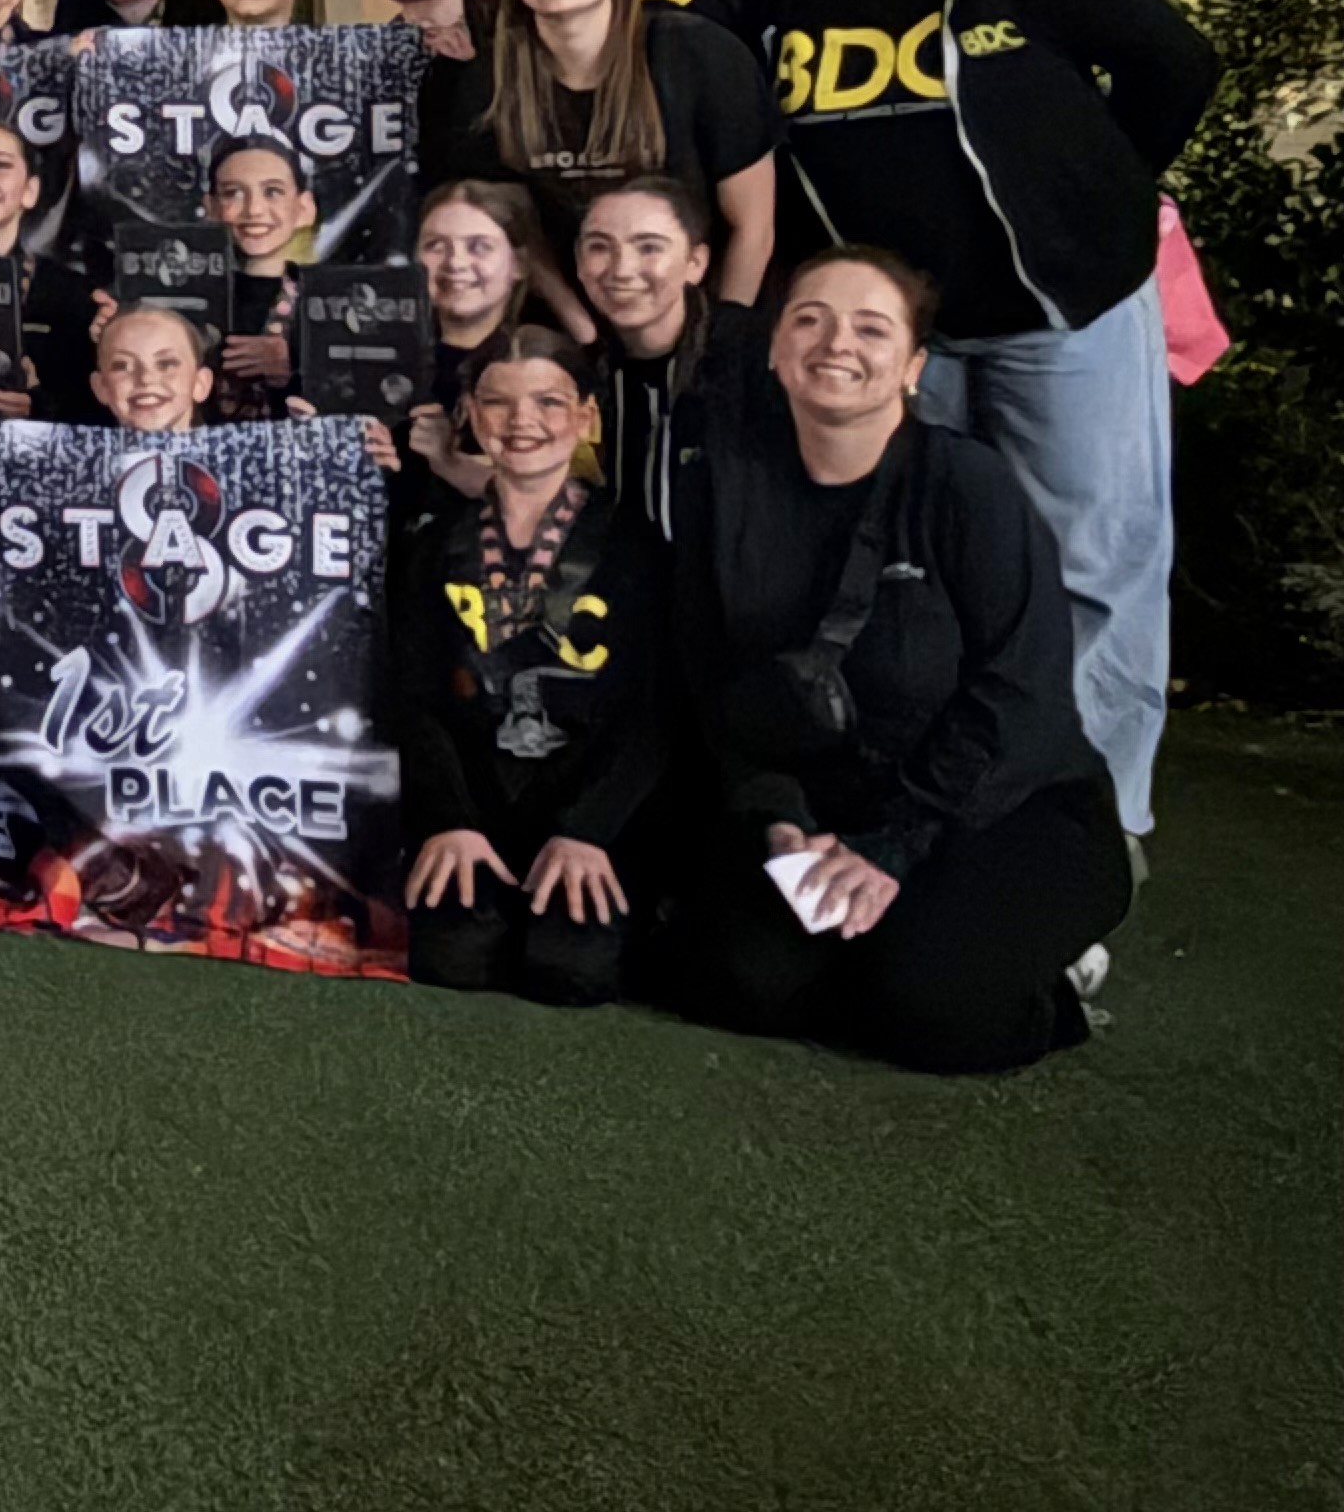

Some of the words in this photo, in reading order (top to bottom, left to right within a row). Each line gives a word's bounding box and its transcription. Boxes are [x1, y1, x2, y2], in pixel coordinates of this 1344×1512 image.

[778, 10, 949, 115] BDC
[961, 20, 1027, 57] BDC
[107, 102, 404, 155] STAGE
[0, 505, 350, 578] STAGE
[39, 645, 186, 762] 1st
[104, 764, 348, 841] PLACE
